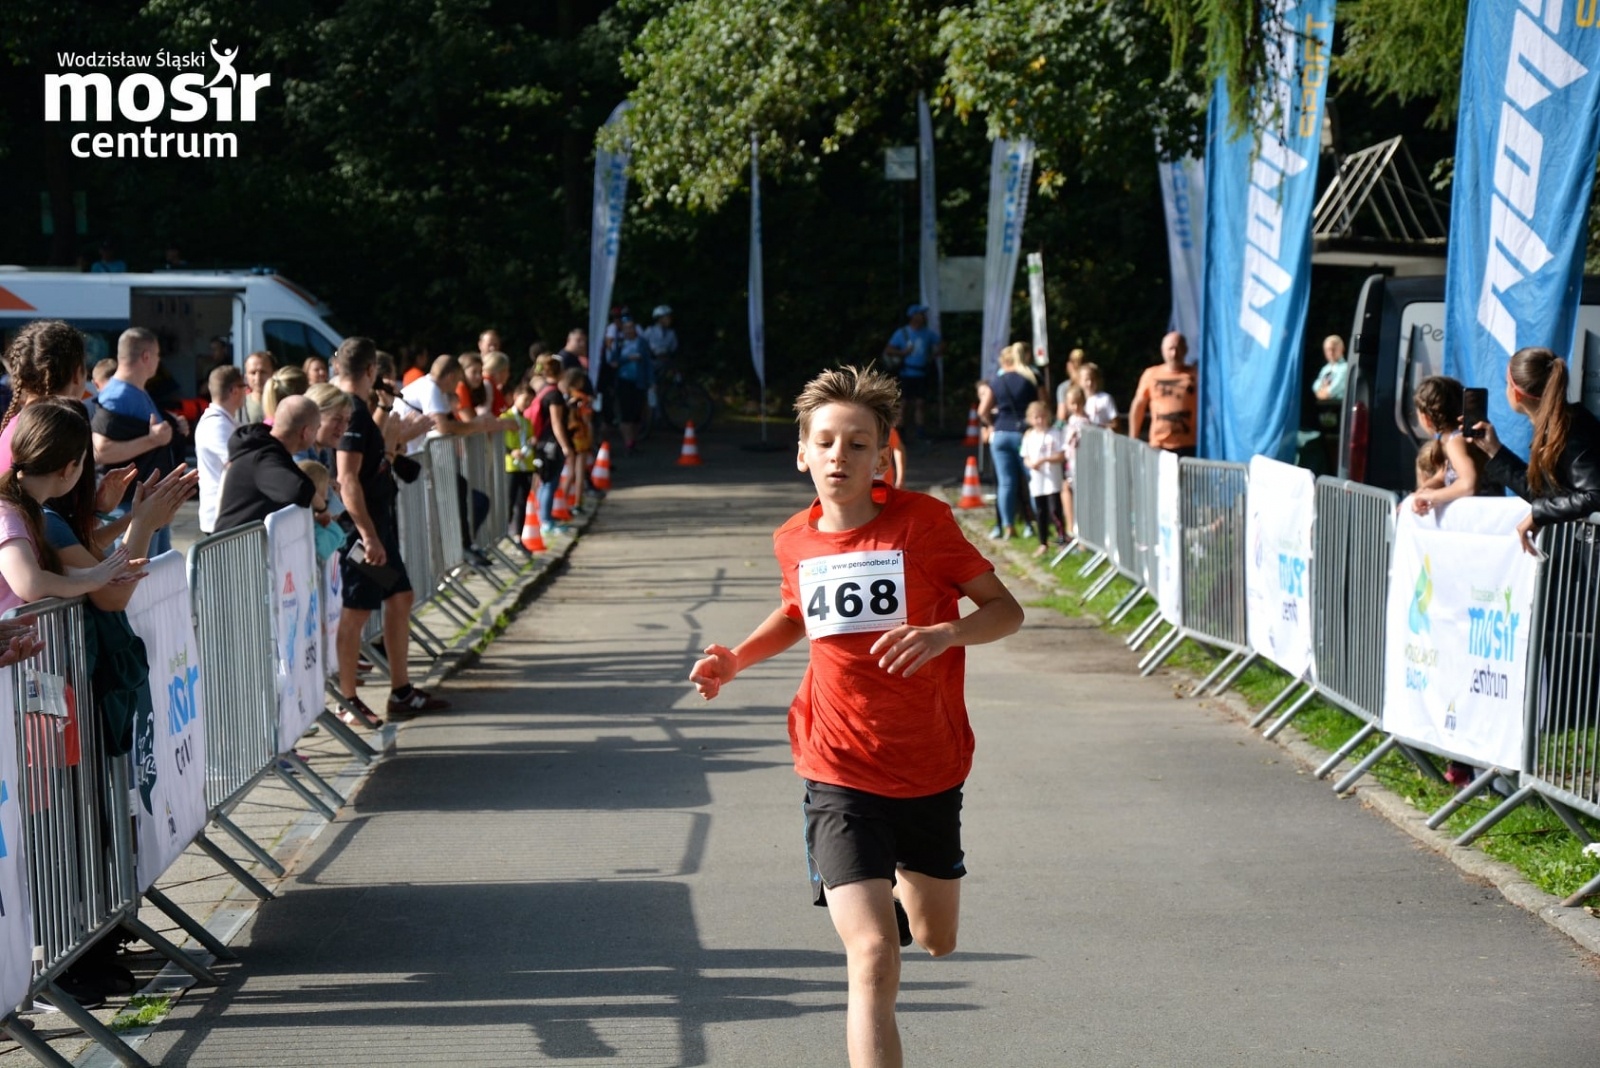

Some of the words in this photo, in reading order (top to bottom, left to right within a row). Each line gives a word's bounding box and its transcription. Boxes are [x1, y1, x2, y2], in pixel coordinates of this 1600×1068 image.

[1299, 13, 1328, 138] SPORT
[831, 557, 899, 570] www.personalbest.pl
[807, 579, 899, 621] 468
[1470, 664, 1508, 700] entrum
